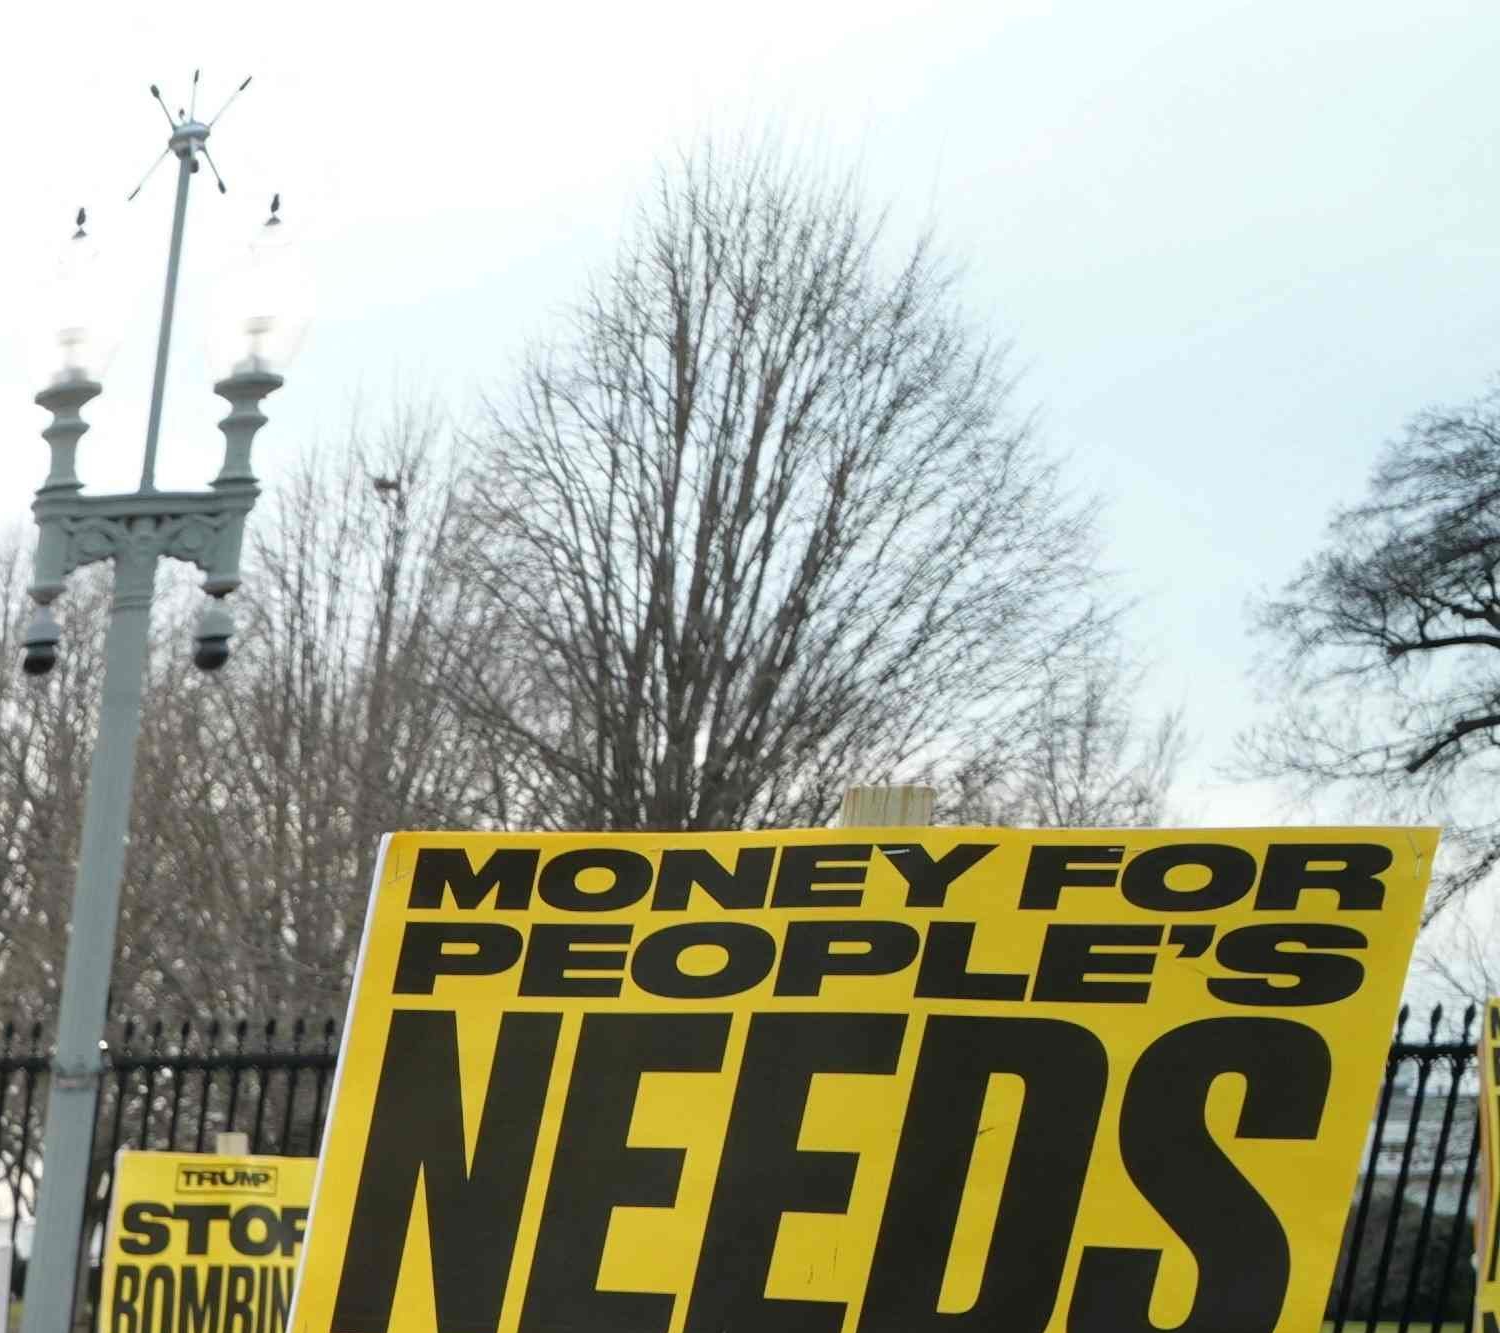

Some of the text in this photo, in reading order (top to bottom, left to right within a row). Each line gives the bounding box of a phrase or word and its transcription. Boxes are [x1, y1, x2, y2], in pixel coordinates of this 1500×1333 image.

[408, 843, 1393, 912] MONEY FOR
[393, 921, 1368, 1007] PEOPLE'S
[181, 1169, 271, 1187] TRUMP
